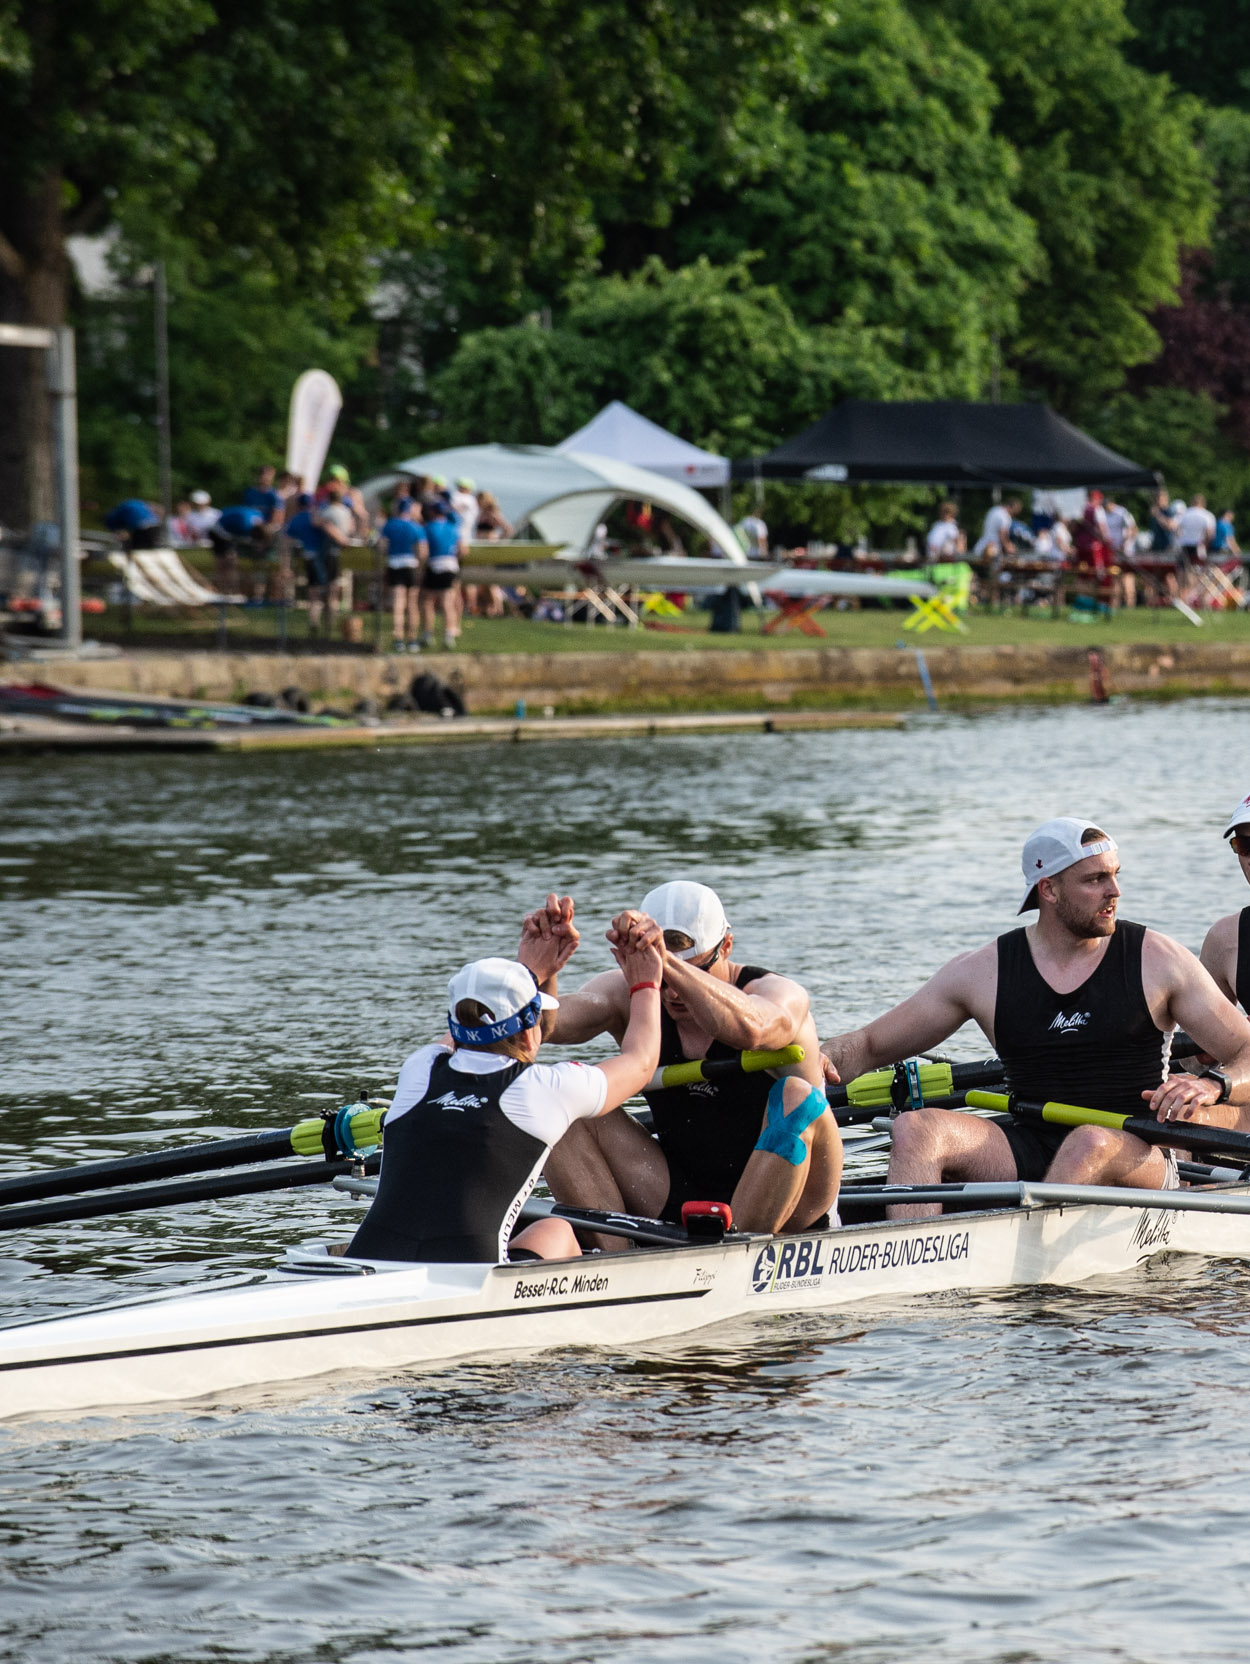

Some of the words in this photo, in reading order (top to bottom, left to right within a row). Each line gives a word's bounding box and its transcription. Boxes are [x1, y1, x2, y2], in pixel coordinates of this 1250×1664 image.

[465, 1029, 482, 1042] NK
[491, 1023, 509, 1039] NK
[776, 1240, 824, 1279] RBL
[828, 1232, 970, 1275] RUDER-BUNDESLIGA
[570, 1273, 609, 1294] Minden
